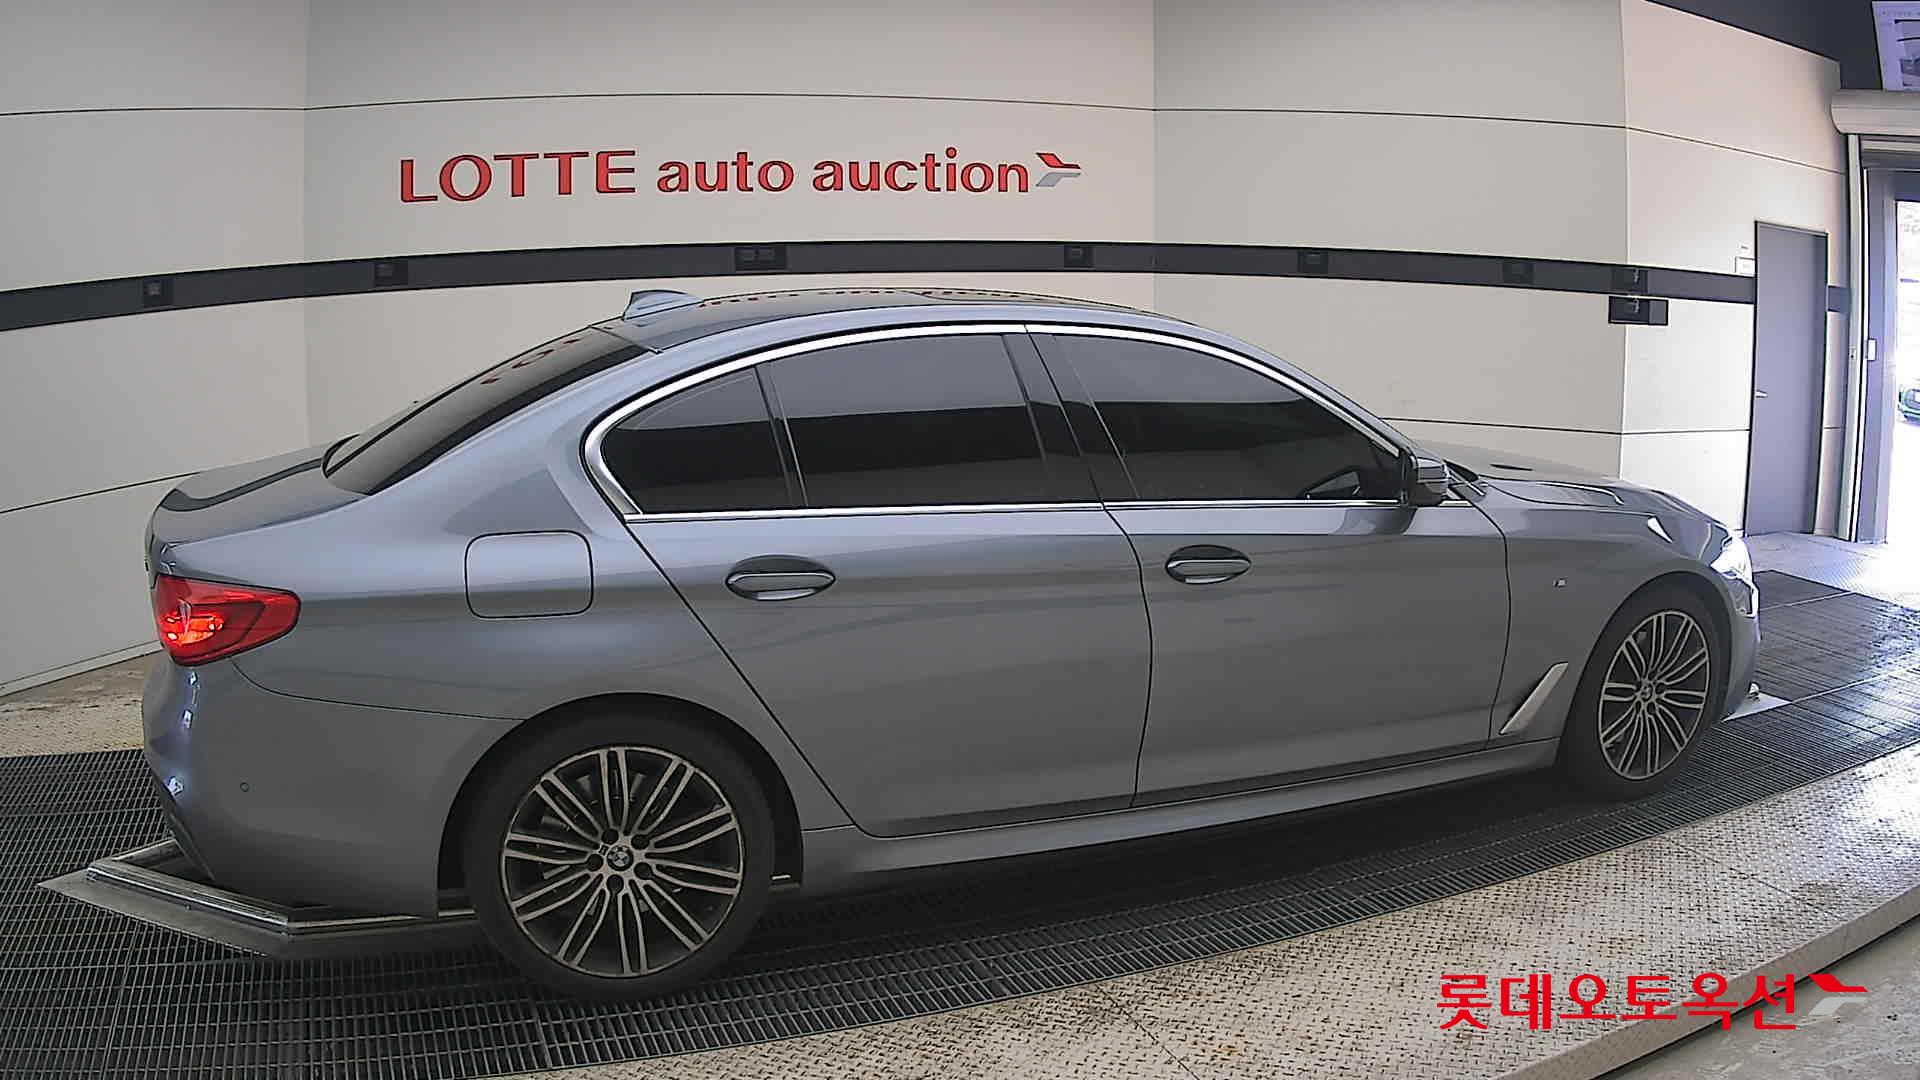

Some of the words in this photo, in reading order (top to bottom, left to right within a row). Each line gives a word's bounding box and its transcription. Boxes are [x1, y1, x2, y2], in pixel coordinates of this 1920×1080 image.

[400, 150, 637, 204] LOTTE
[656, 151, 795, 193] auto
[813, 146, 1030, 193] auction
